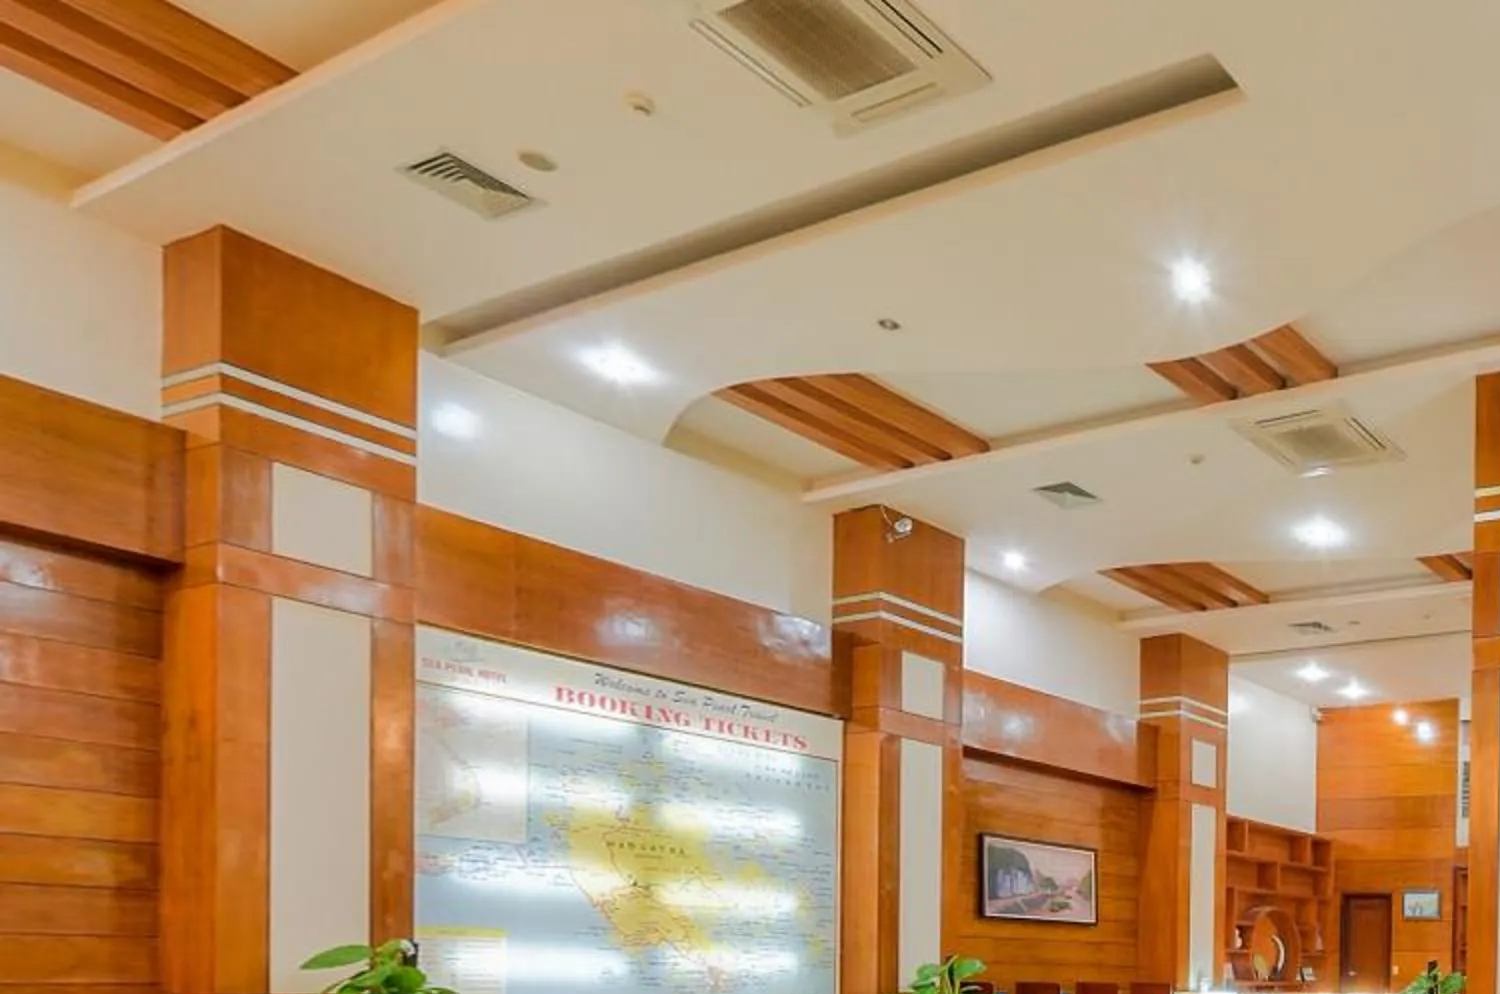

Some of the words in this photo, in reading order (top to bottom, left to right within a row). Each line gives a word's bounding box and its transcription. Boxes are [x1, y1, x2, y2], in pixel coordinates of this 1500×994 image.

[593, 672, 651, 697] Welcome
[553, 685, 691, 727] BOOKING
[703, 714, 809, 750] TICKETS
